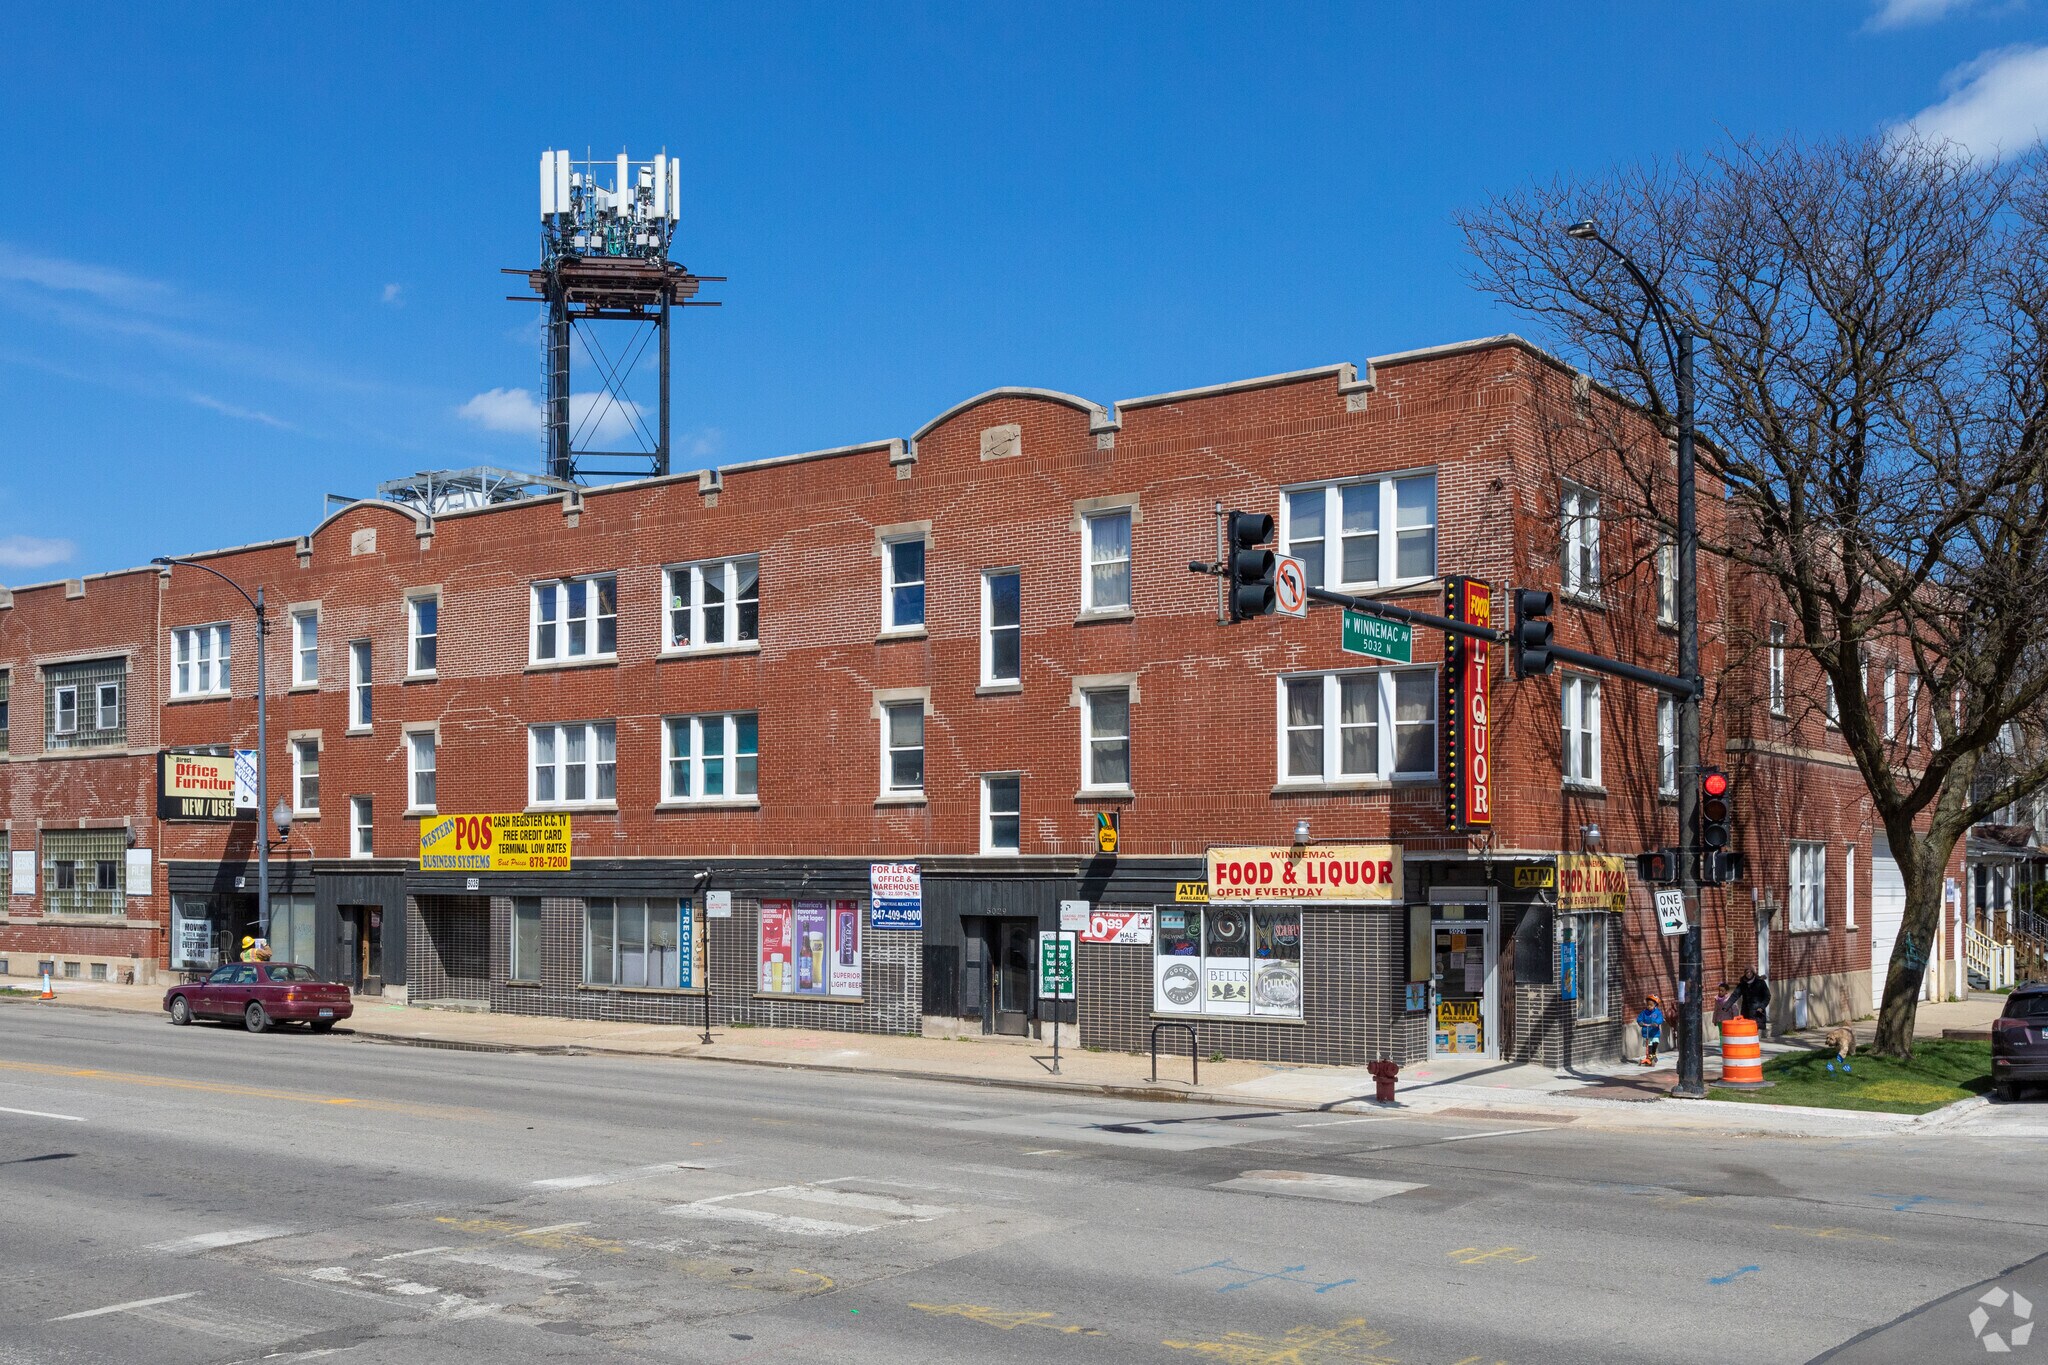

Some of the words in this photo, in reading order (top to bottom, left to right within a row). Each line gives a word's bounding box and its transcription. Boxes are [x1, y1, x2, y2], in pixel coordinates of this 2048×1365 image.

[1471, 595, 1489, 618] FOOD
[1345, 618, 1351, 628] W
[1353, 618, 1399, 642] WINNEMAC
[1401, 631, 1409, 642] AV
[1363, 639, 1382, 653] 5032
[1386, 644, 1391, 654] N
[1472, 637, 1488, 813] LIQUOR
[175, 764, 218, 777] Office
[175, 776, 235, 790] Furnitur
[494, 816, 510, 828] CASH
[511, 815, 542, 827] REGISTER
[544, 815, 557, 827] C.C.
[558, 814, 567, 826] TV
[421, 816, 455, 849] WESTERN
[455, 816, 492, 851] POS
[503, 830, 518, 841] FREE
[520, 830, 542, 840] CREDIT
[544, 829, 562, 840] CARD
[498, 843, 529, 854] TERMINAL
[531, 843, 545, 854] LOW
[547, 843, 567, 854] RATES
[1270, 851, 1335, 859] WINNEMAC
[423, 855, 456, 868] BUSINESS
[457, 855, 491, 869] SYSTEMS
[529, 856, 568, 868] 878-7200
[872, 865, 889, 874] FOR
[892, 865, 920, 874] LEASE
[1216, 862, 1273, 885] FOOD
[1282, 861, 1298, 884] &
[1306, 860, 1394, 888] LIQUOR
[1518, 869, 1551, 881] ATM
[873, 883, 920, 891] WAREHOUSE
[1560, 869, 1583, 893] FOOD
[1586, 869, 1591, 893] &
[1594, 869, 1626, 895] LIQUOR
[1178, 885, 1208, 895] ATM
[1217, 887, 1251, 897] OPEN
[1255, 887, 1323, 897] EVERYDAY
[1575, 896, 1600, 905] EVERYDAY
[1610, 894, 1626, 906] ATM
[1659, 894, 1680, 906] ONE
[873, 909, 920, 921] 847-409-4900
[1661, 906, 1681, 917] WAY
[184, 923, 208, 931] MOVING
[182, 941, 209, 949] EVERYTHING
[682, 916, 690, 982] REGISTERS
[1169, 967, 1192, 977] GOOSE
[1210, 970, 1249, 982] BELL'S
[1169, 991, 1194, 1002] ISLAND
[1441, 1002, 1475, 1016] ATM
